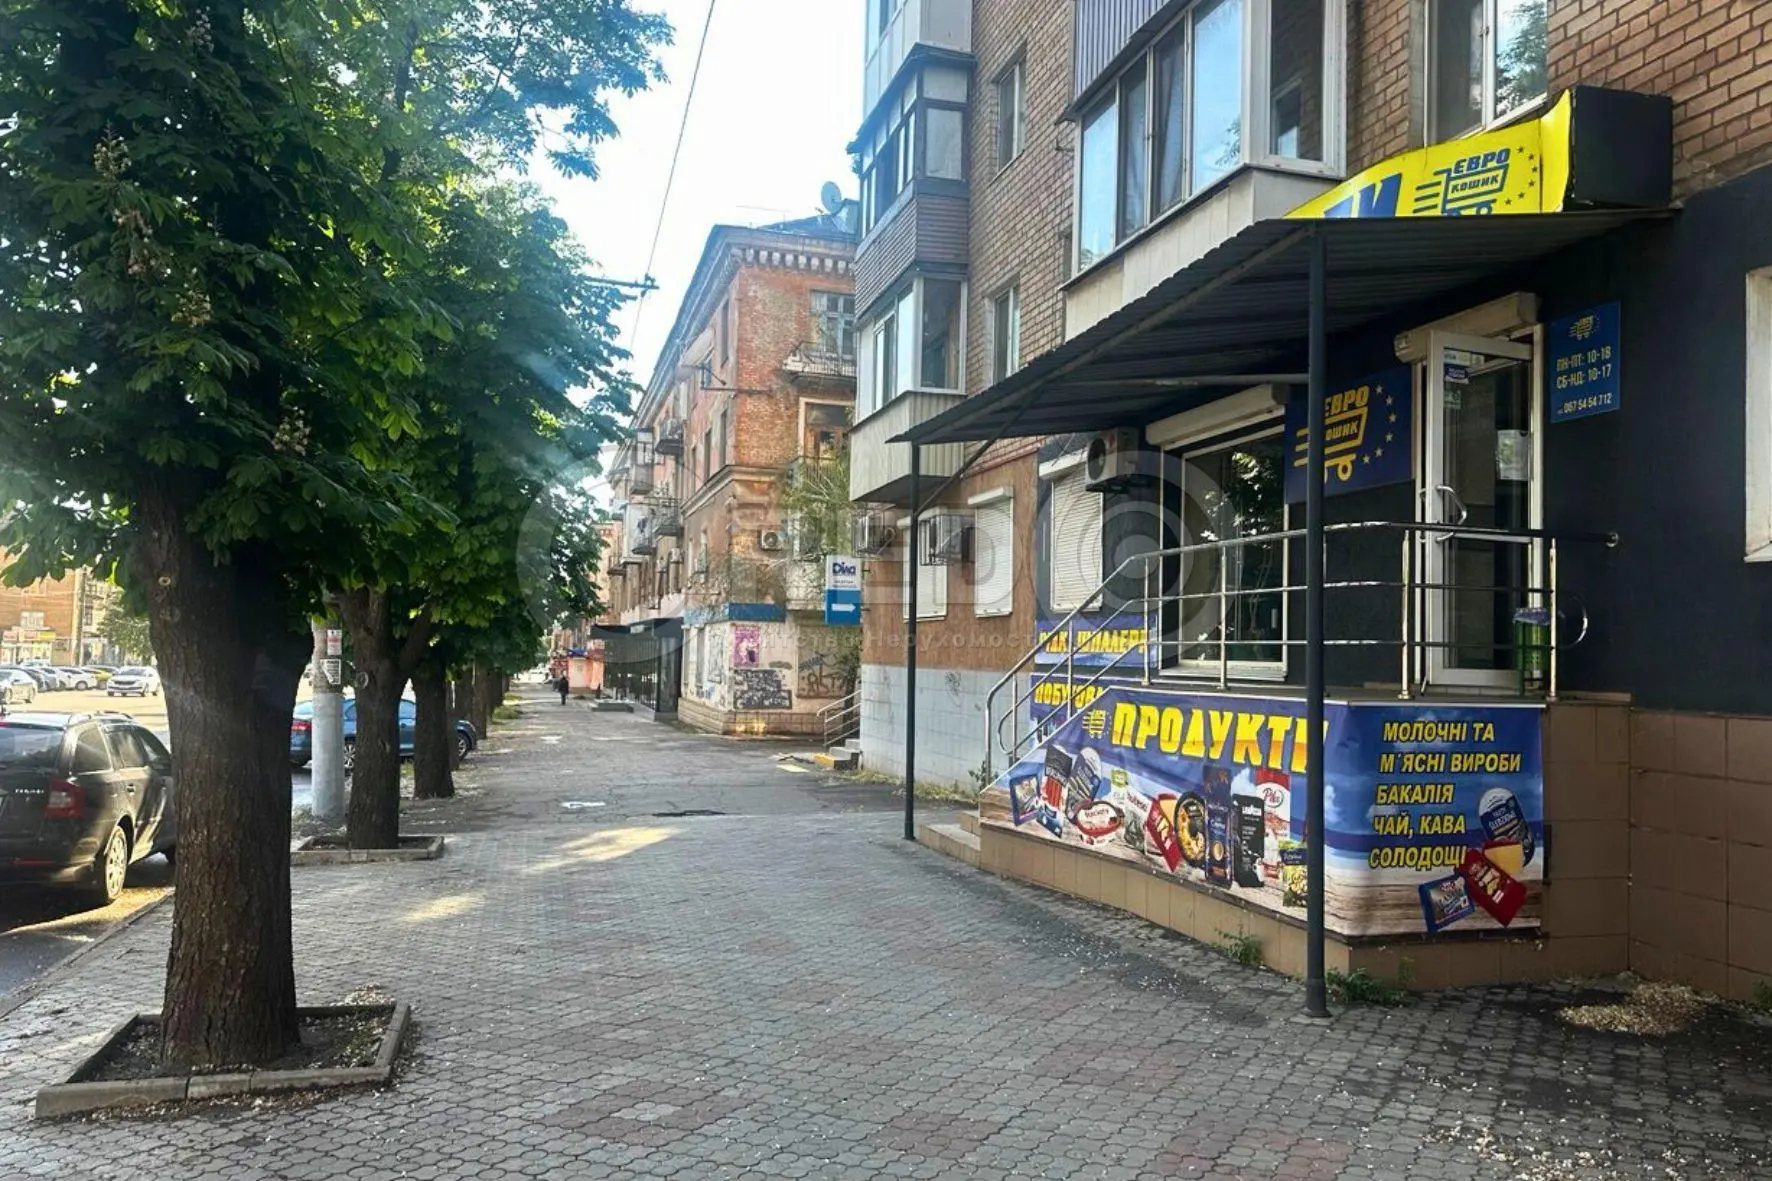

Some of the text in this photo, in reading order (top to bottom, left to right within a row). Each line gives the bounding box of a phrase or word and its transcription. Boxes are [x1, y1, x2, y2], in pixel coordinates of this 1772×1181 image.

[1453, 148, 1510, 175] ЕВРО
[1451, 174, 1500, 194] КОШИК
[1325, 420, 1358, 441] ОШИК
[1383, 721, 1495, 742] МОЛОЧНІ ТА
[1451, 753, 1522, 774] ВИРОБИ
[1376, 784, 1455, 804] БАКАЛІЯ
[1373, 811, 1414, 839] ЧАЙ,
[1420, 815, 1466, 835] КАВА
[1369, 846, 1467, 871] СОЛОДОЩІ
